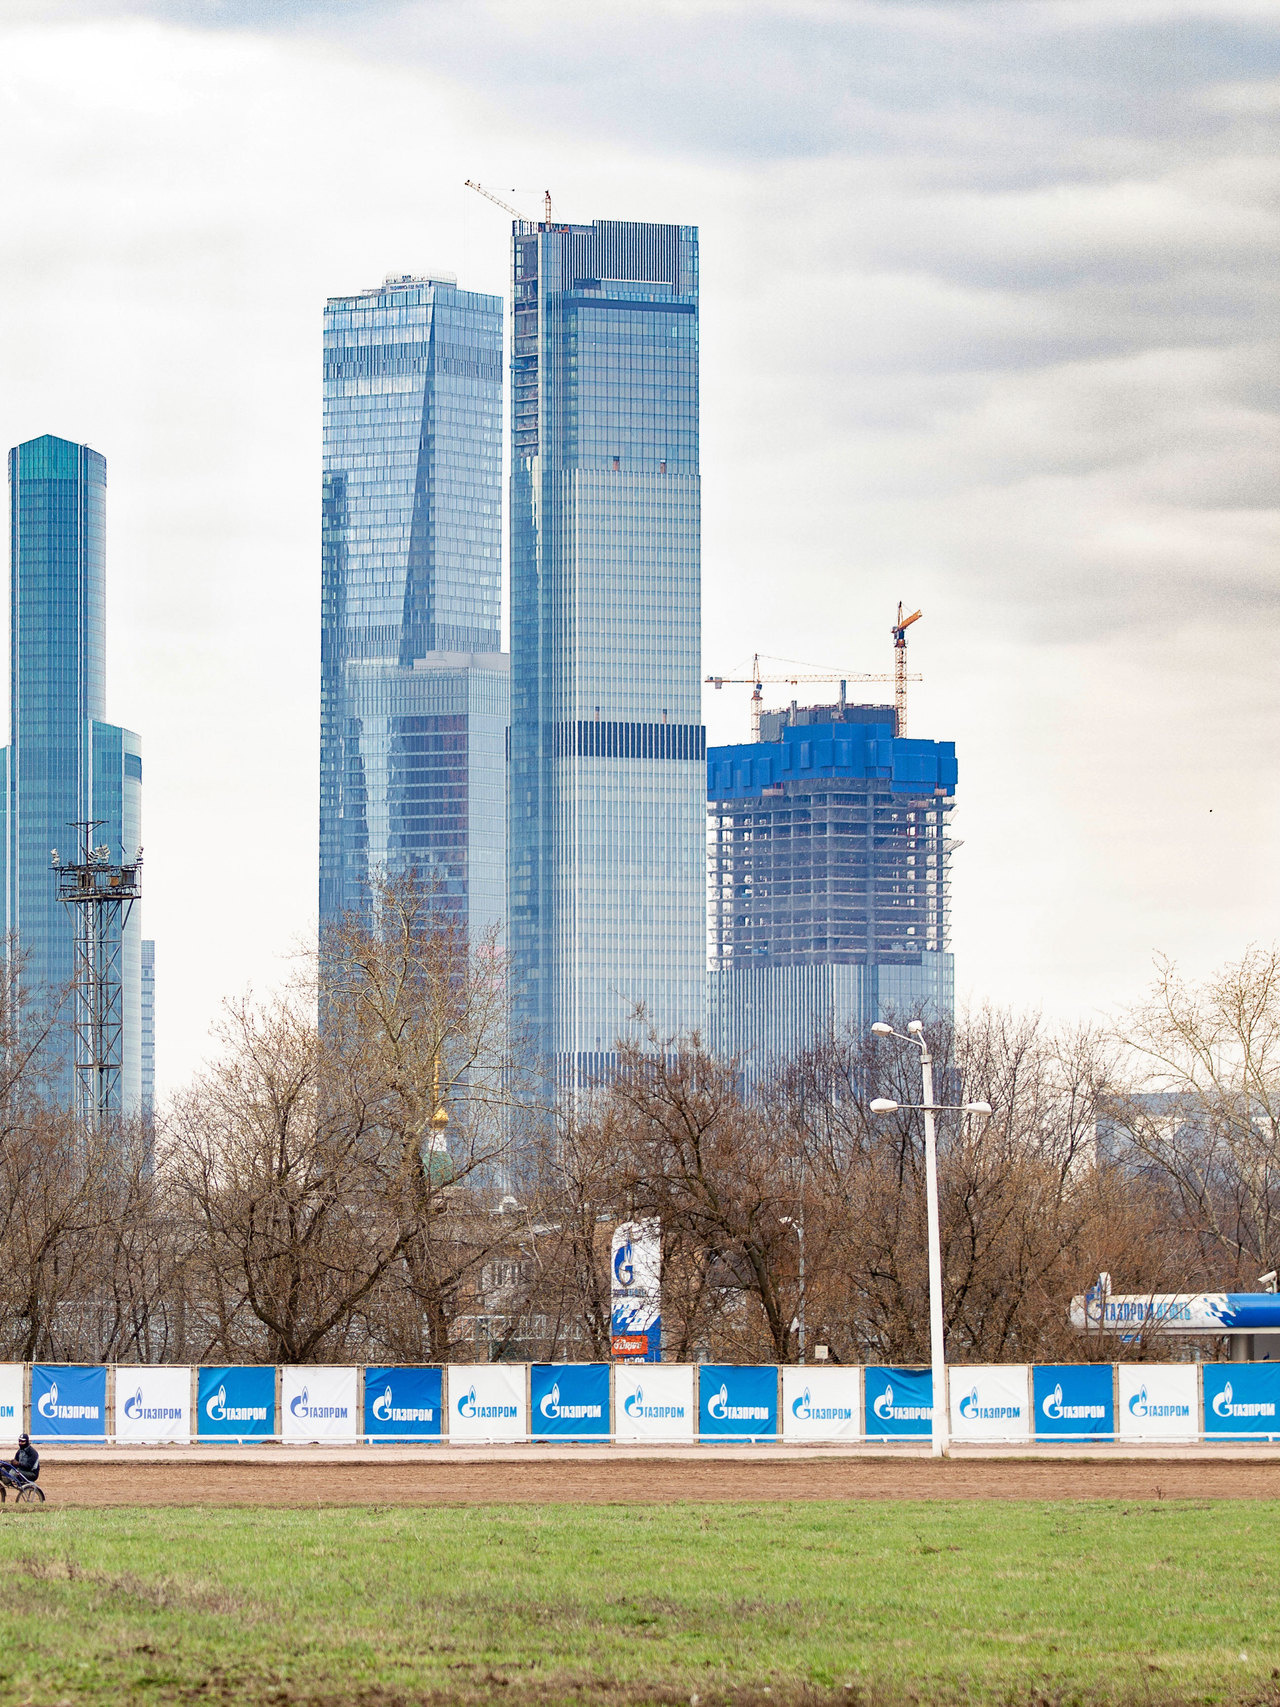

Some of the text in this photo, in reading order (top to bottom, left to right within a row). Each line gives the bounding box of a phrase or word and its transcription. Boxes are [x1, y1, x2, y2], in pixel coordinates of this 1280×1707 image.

[58, 1406, 98, 1419] ГАЗПРОМ
[144, 1409, 181, 1419] ГАЗПРОМ
[227, 1408, 266, 1420] ГАЗПРОМ
[309, 1408, 347, 1418] ГАЗПРОМ
[392, 1409, 432, 1421] ГАЗПРОМ
[477, 1407, 517, 1417] ГАЗПРОМ
[561, 1406, 601, 1418] ГАЗПРОМ
[644, 1407, 684, 1417] ГАЗПРОМ
[728, 1407, 768, 1419] ГАЗПРОМ
[812, 1409, 851, 1419] ГАЗПРОМ
[980, 1408, 1020, 1418] ГАЗПРОМ
[1063, 1406, 1105, 1418] ГАЗПРОМ
[1149, 1406, 1189, 1416] ГАЗПРОМ
[1234, 1404, 1275, 1416] ГАЗПРОМ
